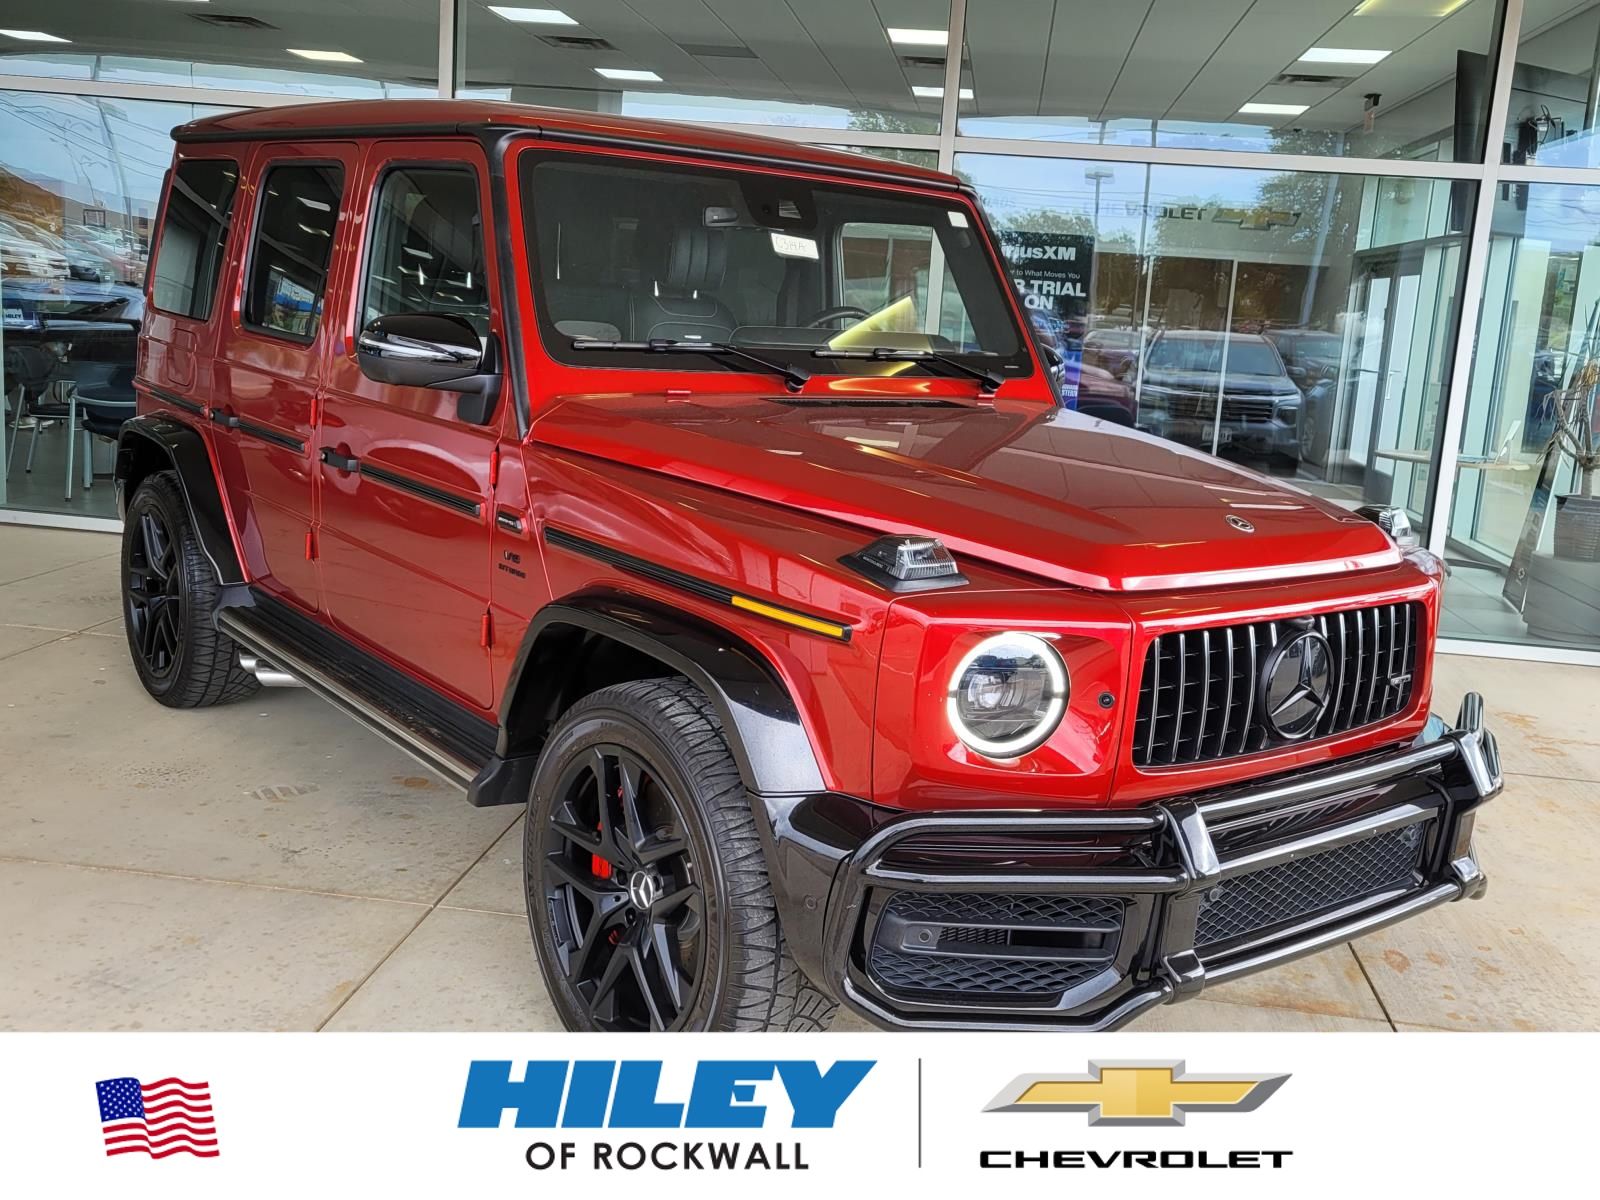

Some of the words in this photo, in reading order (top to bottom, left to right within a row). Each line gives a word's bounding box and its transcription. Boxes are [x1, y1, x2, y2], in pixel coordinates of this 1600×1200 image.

[1024, 269, 1043, 277] What
[1043, 270, 1066, 279] Moves
[1067, 272, 1081, 280] You
[1030, 279, 1086, 297] TRIAL
[1024, 294, 1054, 311] ON
